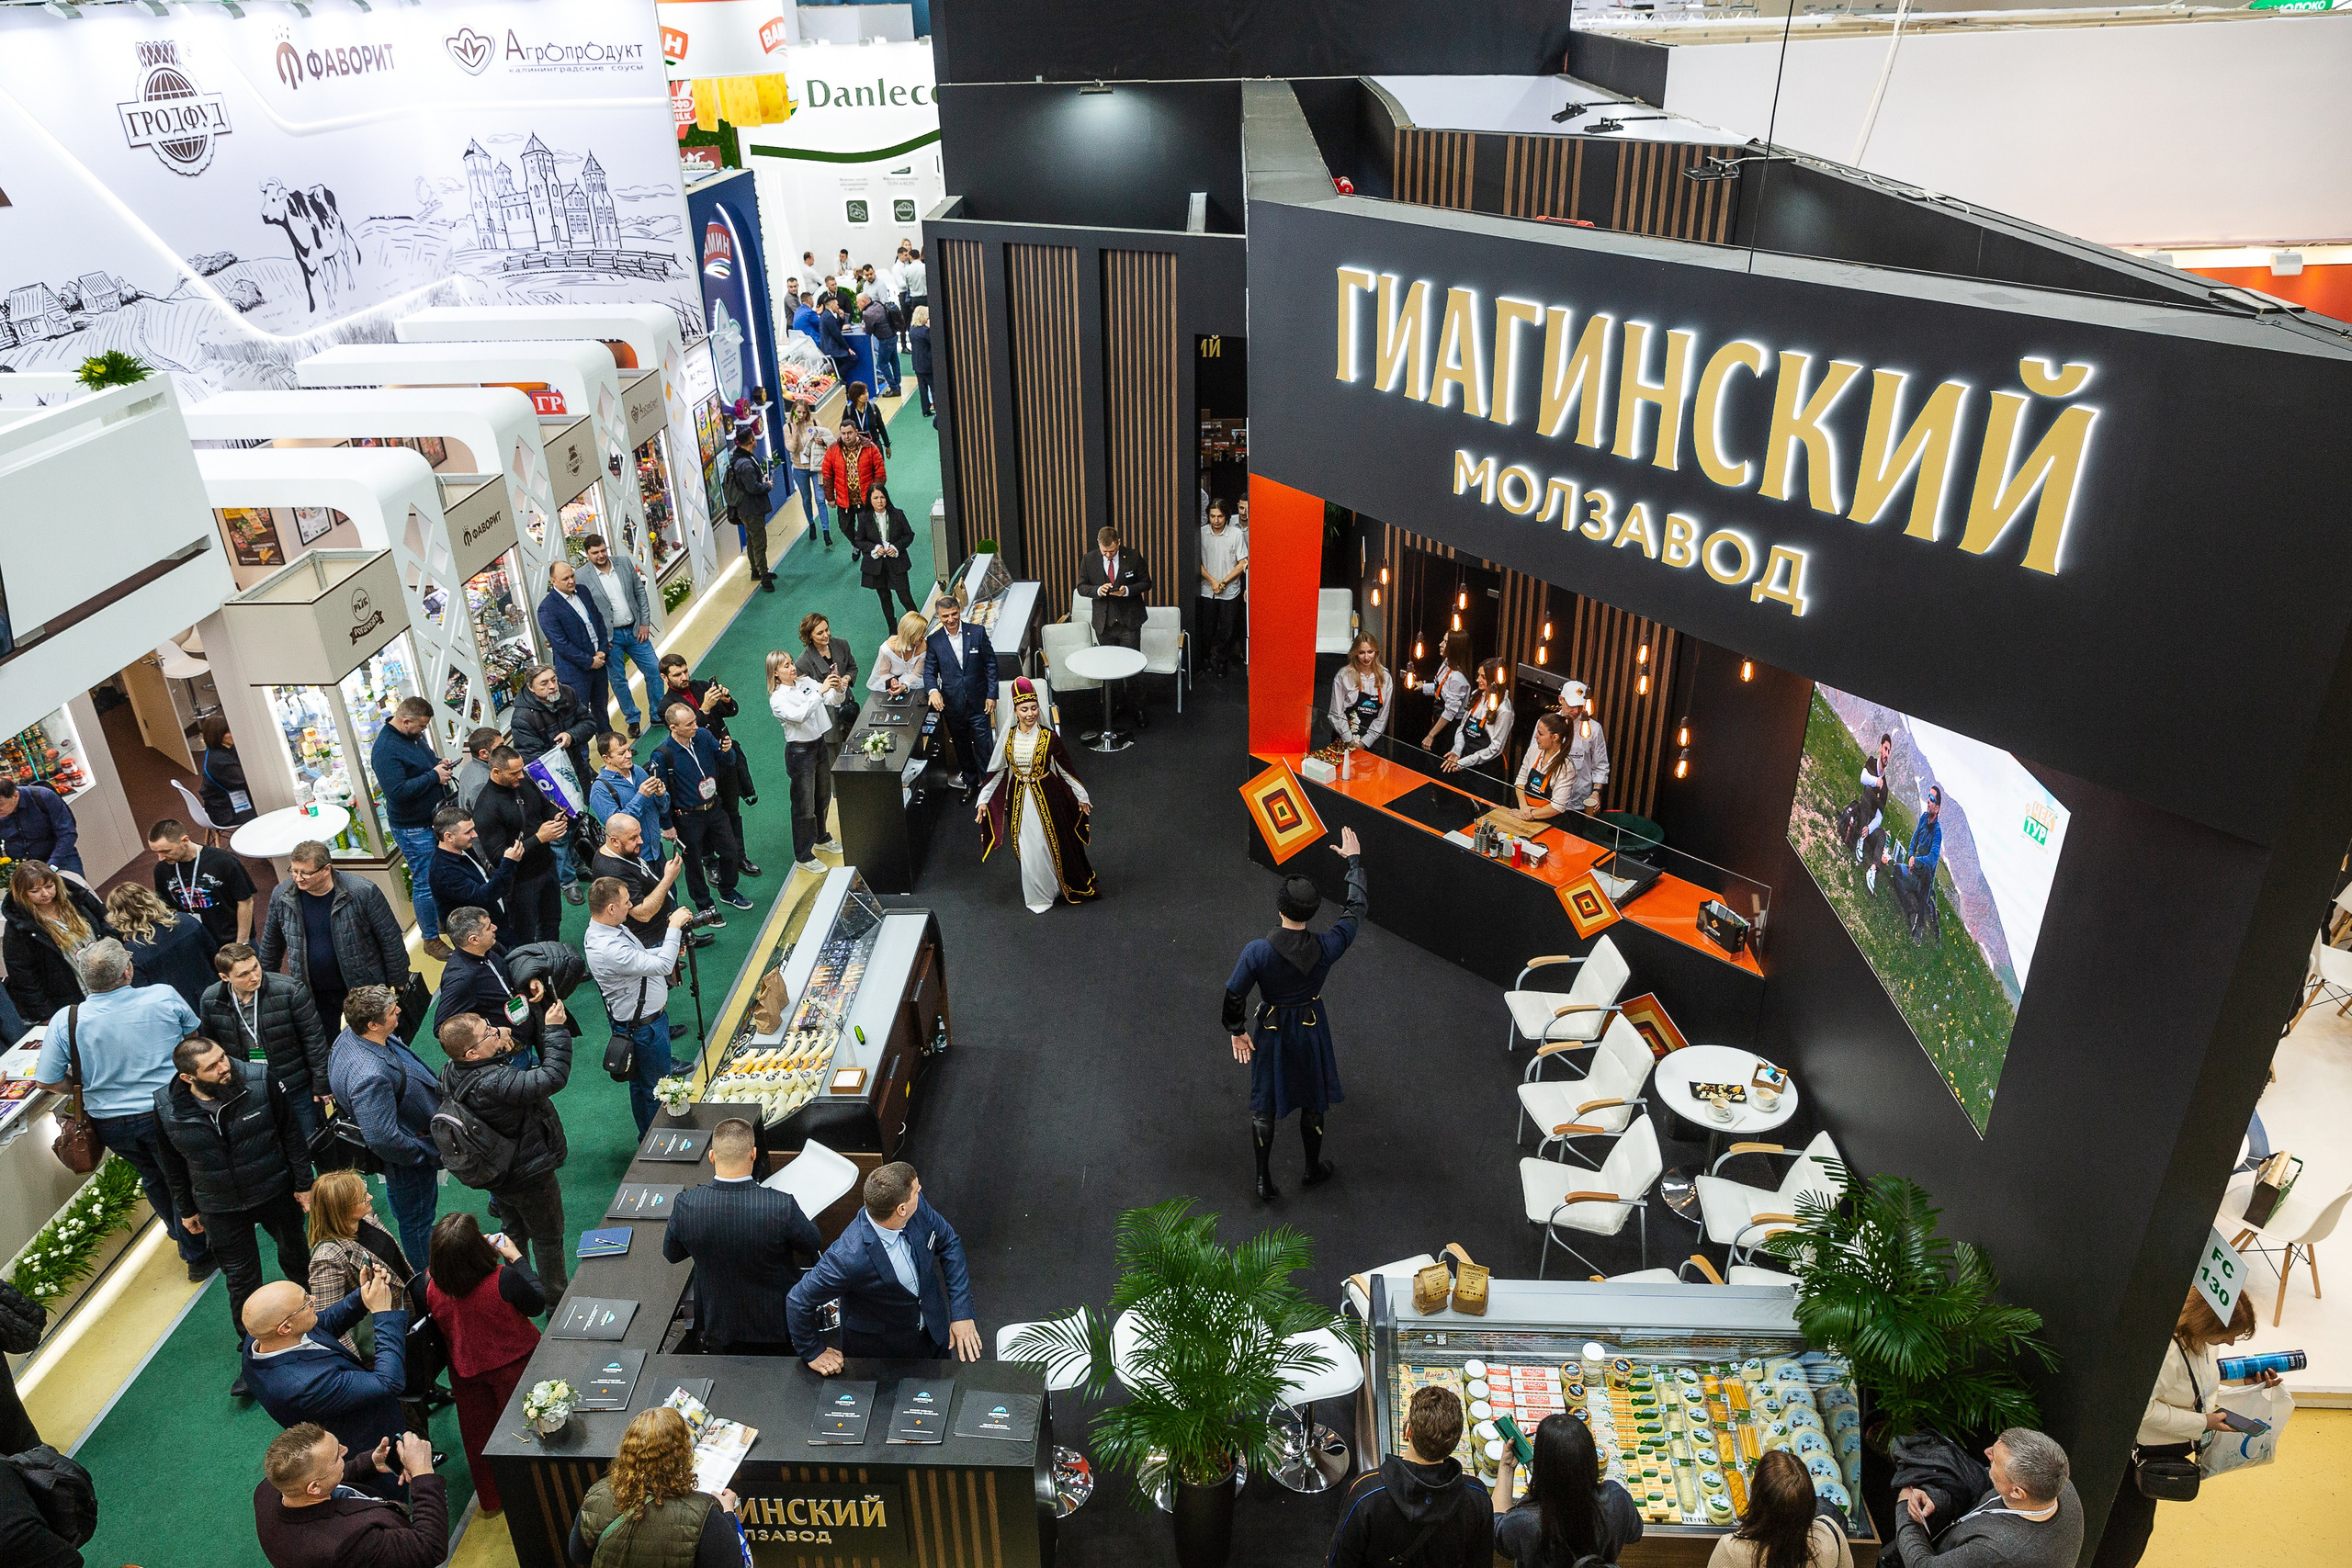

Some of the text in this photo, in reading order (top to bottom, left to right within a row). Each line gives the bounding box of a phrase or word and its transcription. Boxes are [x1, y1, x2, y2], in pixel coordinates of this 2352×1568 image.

[306, 43, 395, 80] ФАВОРИТ
[126, 102, 227, 138] ГРОДФУД
[704, 232, 730, 259] АМИН
[1336, 265, 2102, 578] ГИАГИНСКИЙ
[472, 511, 501, 539] ФАВОРИТ
[1453, 449, 1810, 617] МОЛЗАВОД
[2211, 1246, 2234, 1279] FC
[2201, 1266, 2230, 1306] 130
[735, 1495, 887, 1527] ИНСКИЙ
[743, 1529, 832, 1544] ЛЗАВОД
